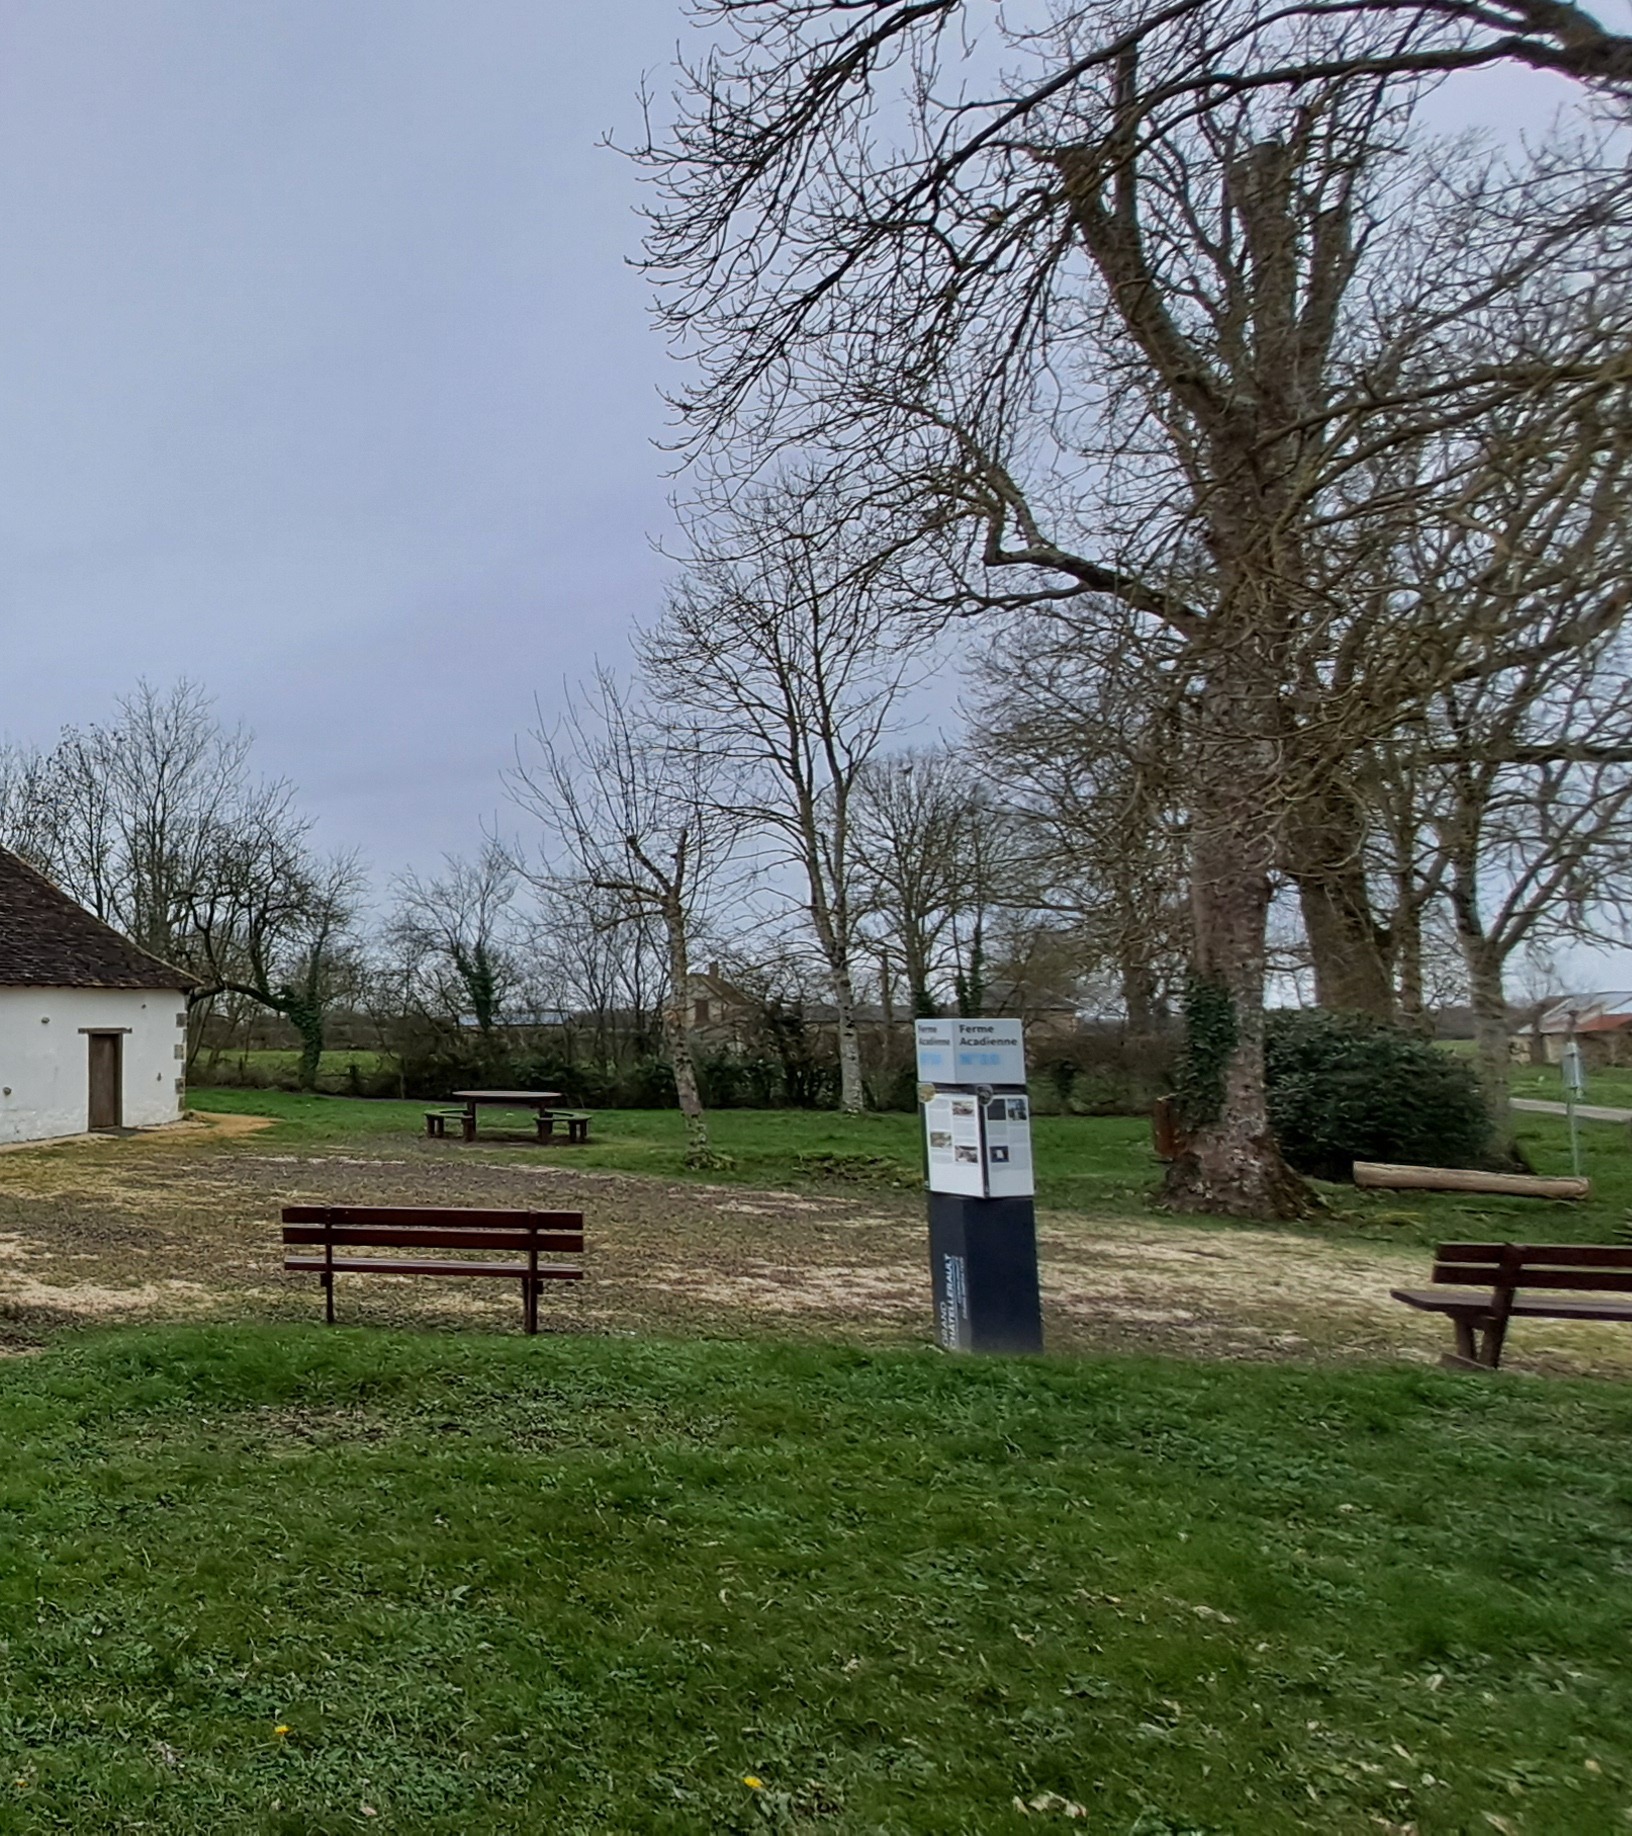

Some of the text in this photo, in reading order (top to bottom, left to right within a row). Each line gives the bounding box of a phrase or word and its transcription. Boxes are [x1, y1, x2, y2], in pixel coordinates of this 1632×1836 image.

[959, 1023, 994, 1033] Ferme
[959, 1037, 1018, 1046] Acadienne
[940, 1301, 949, 1347] GRAND
